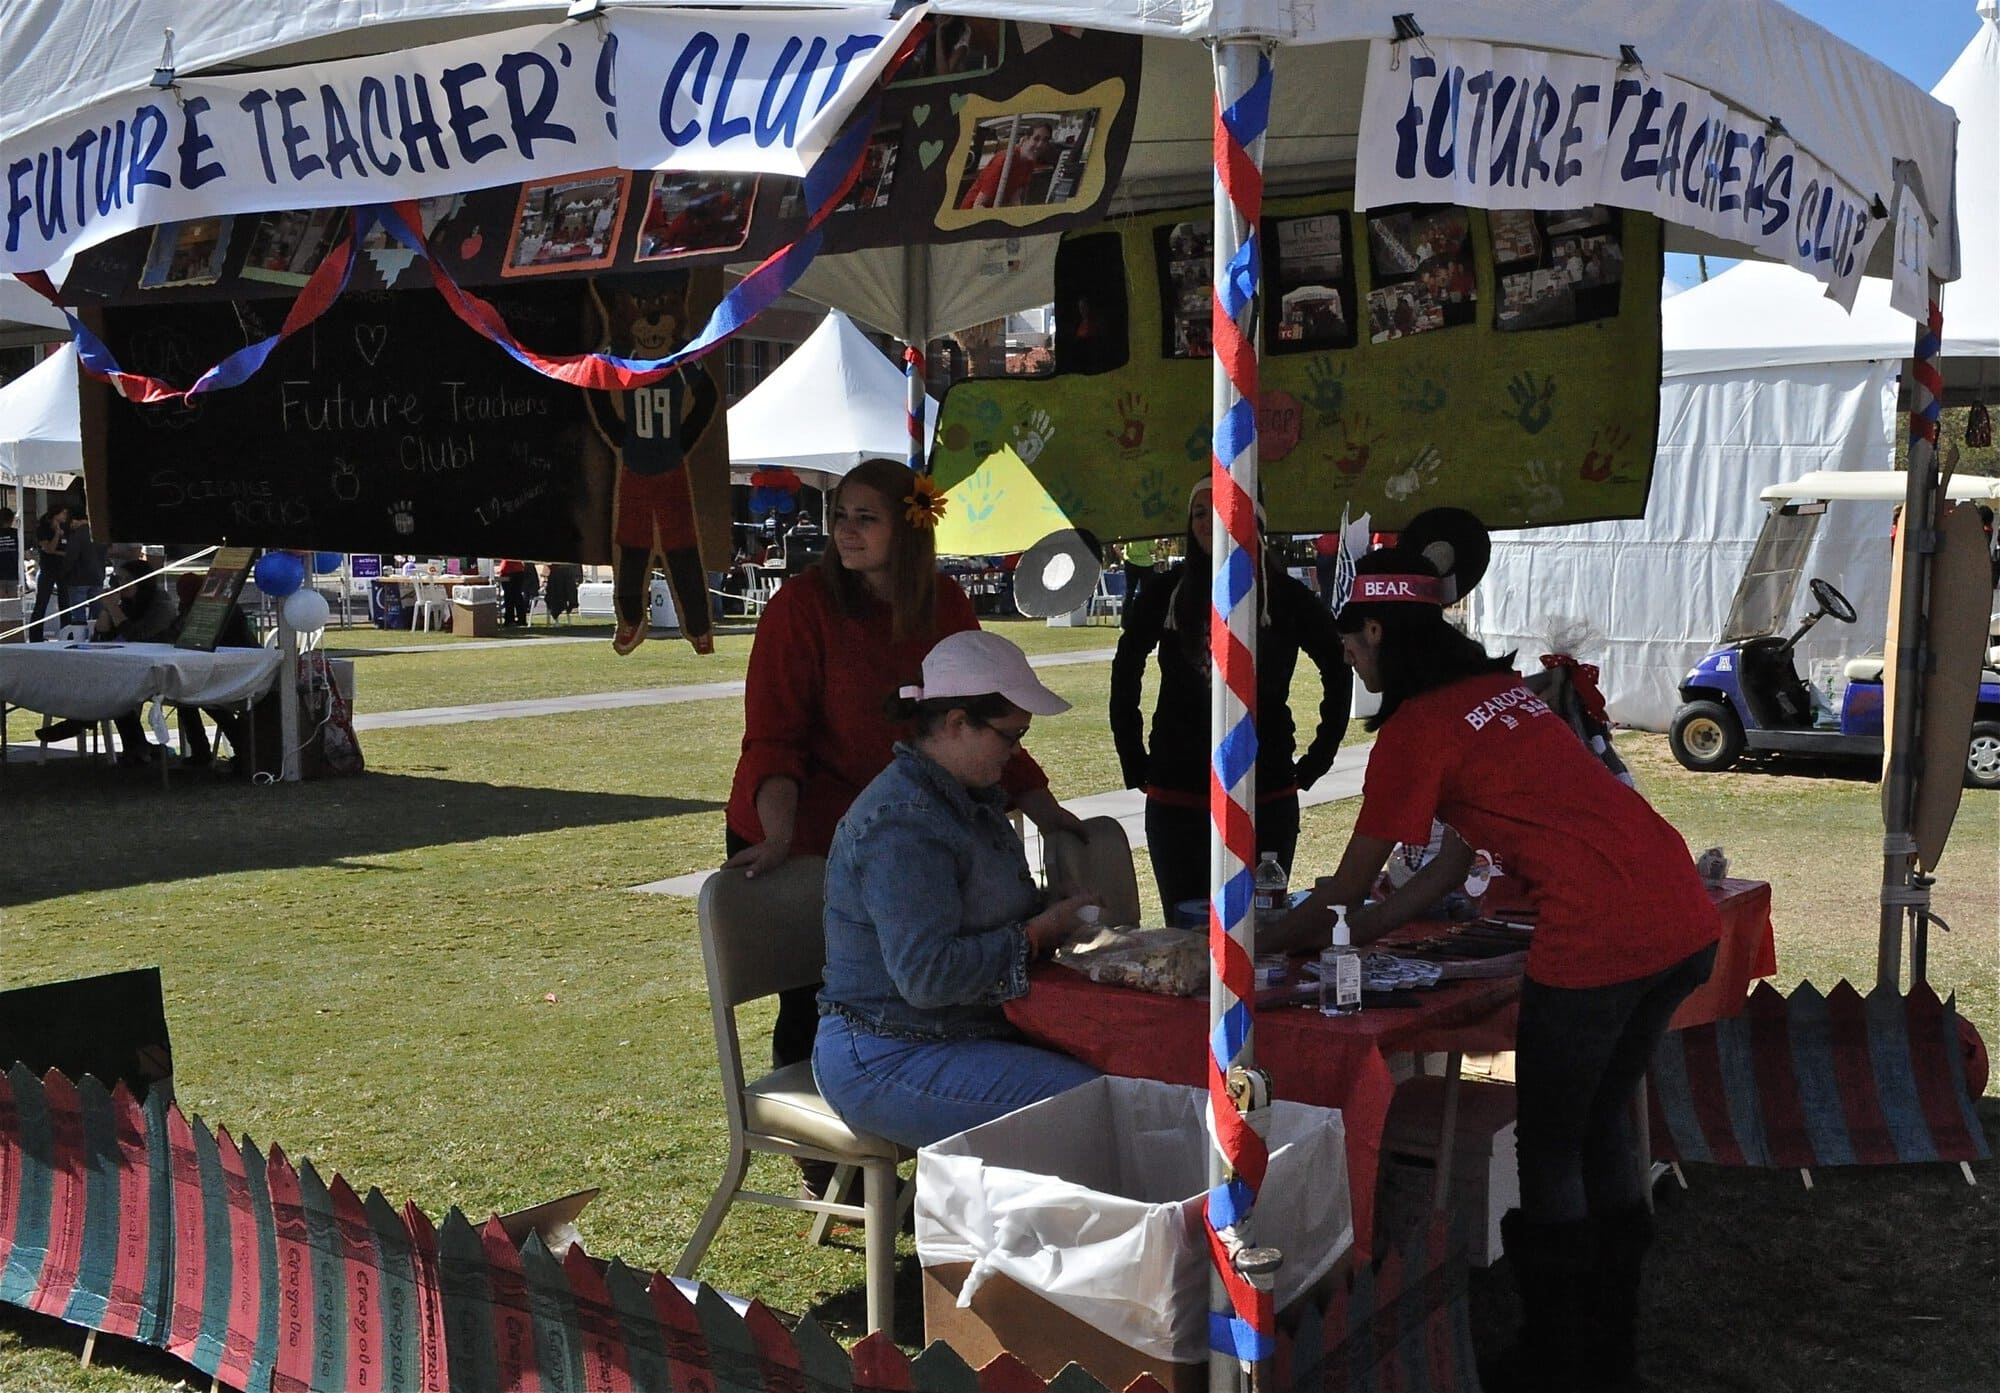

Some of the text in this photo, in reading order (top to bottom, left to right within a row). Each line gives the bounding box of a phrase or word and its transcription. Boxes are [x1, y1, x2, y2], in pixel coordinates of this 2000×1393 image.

[5, 96, 226, 252] FUTURE
[1395, 55, 1600, 189] FUTURE
[1607, 79, 1794, 236] TEACHERS
[280, 381, 548, 433] Future Teachers
[633, 387, 671, 439] 09
[1365, 580, 1416, 597] BEAR
[286, 1247, 301, 1348] Crayola
[353, 1270, 370, 1387] Crayola
